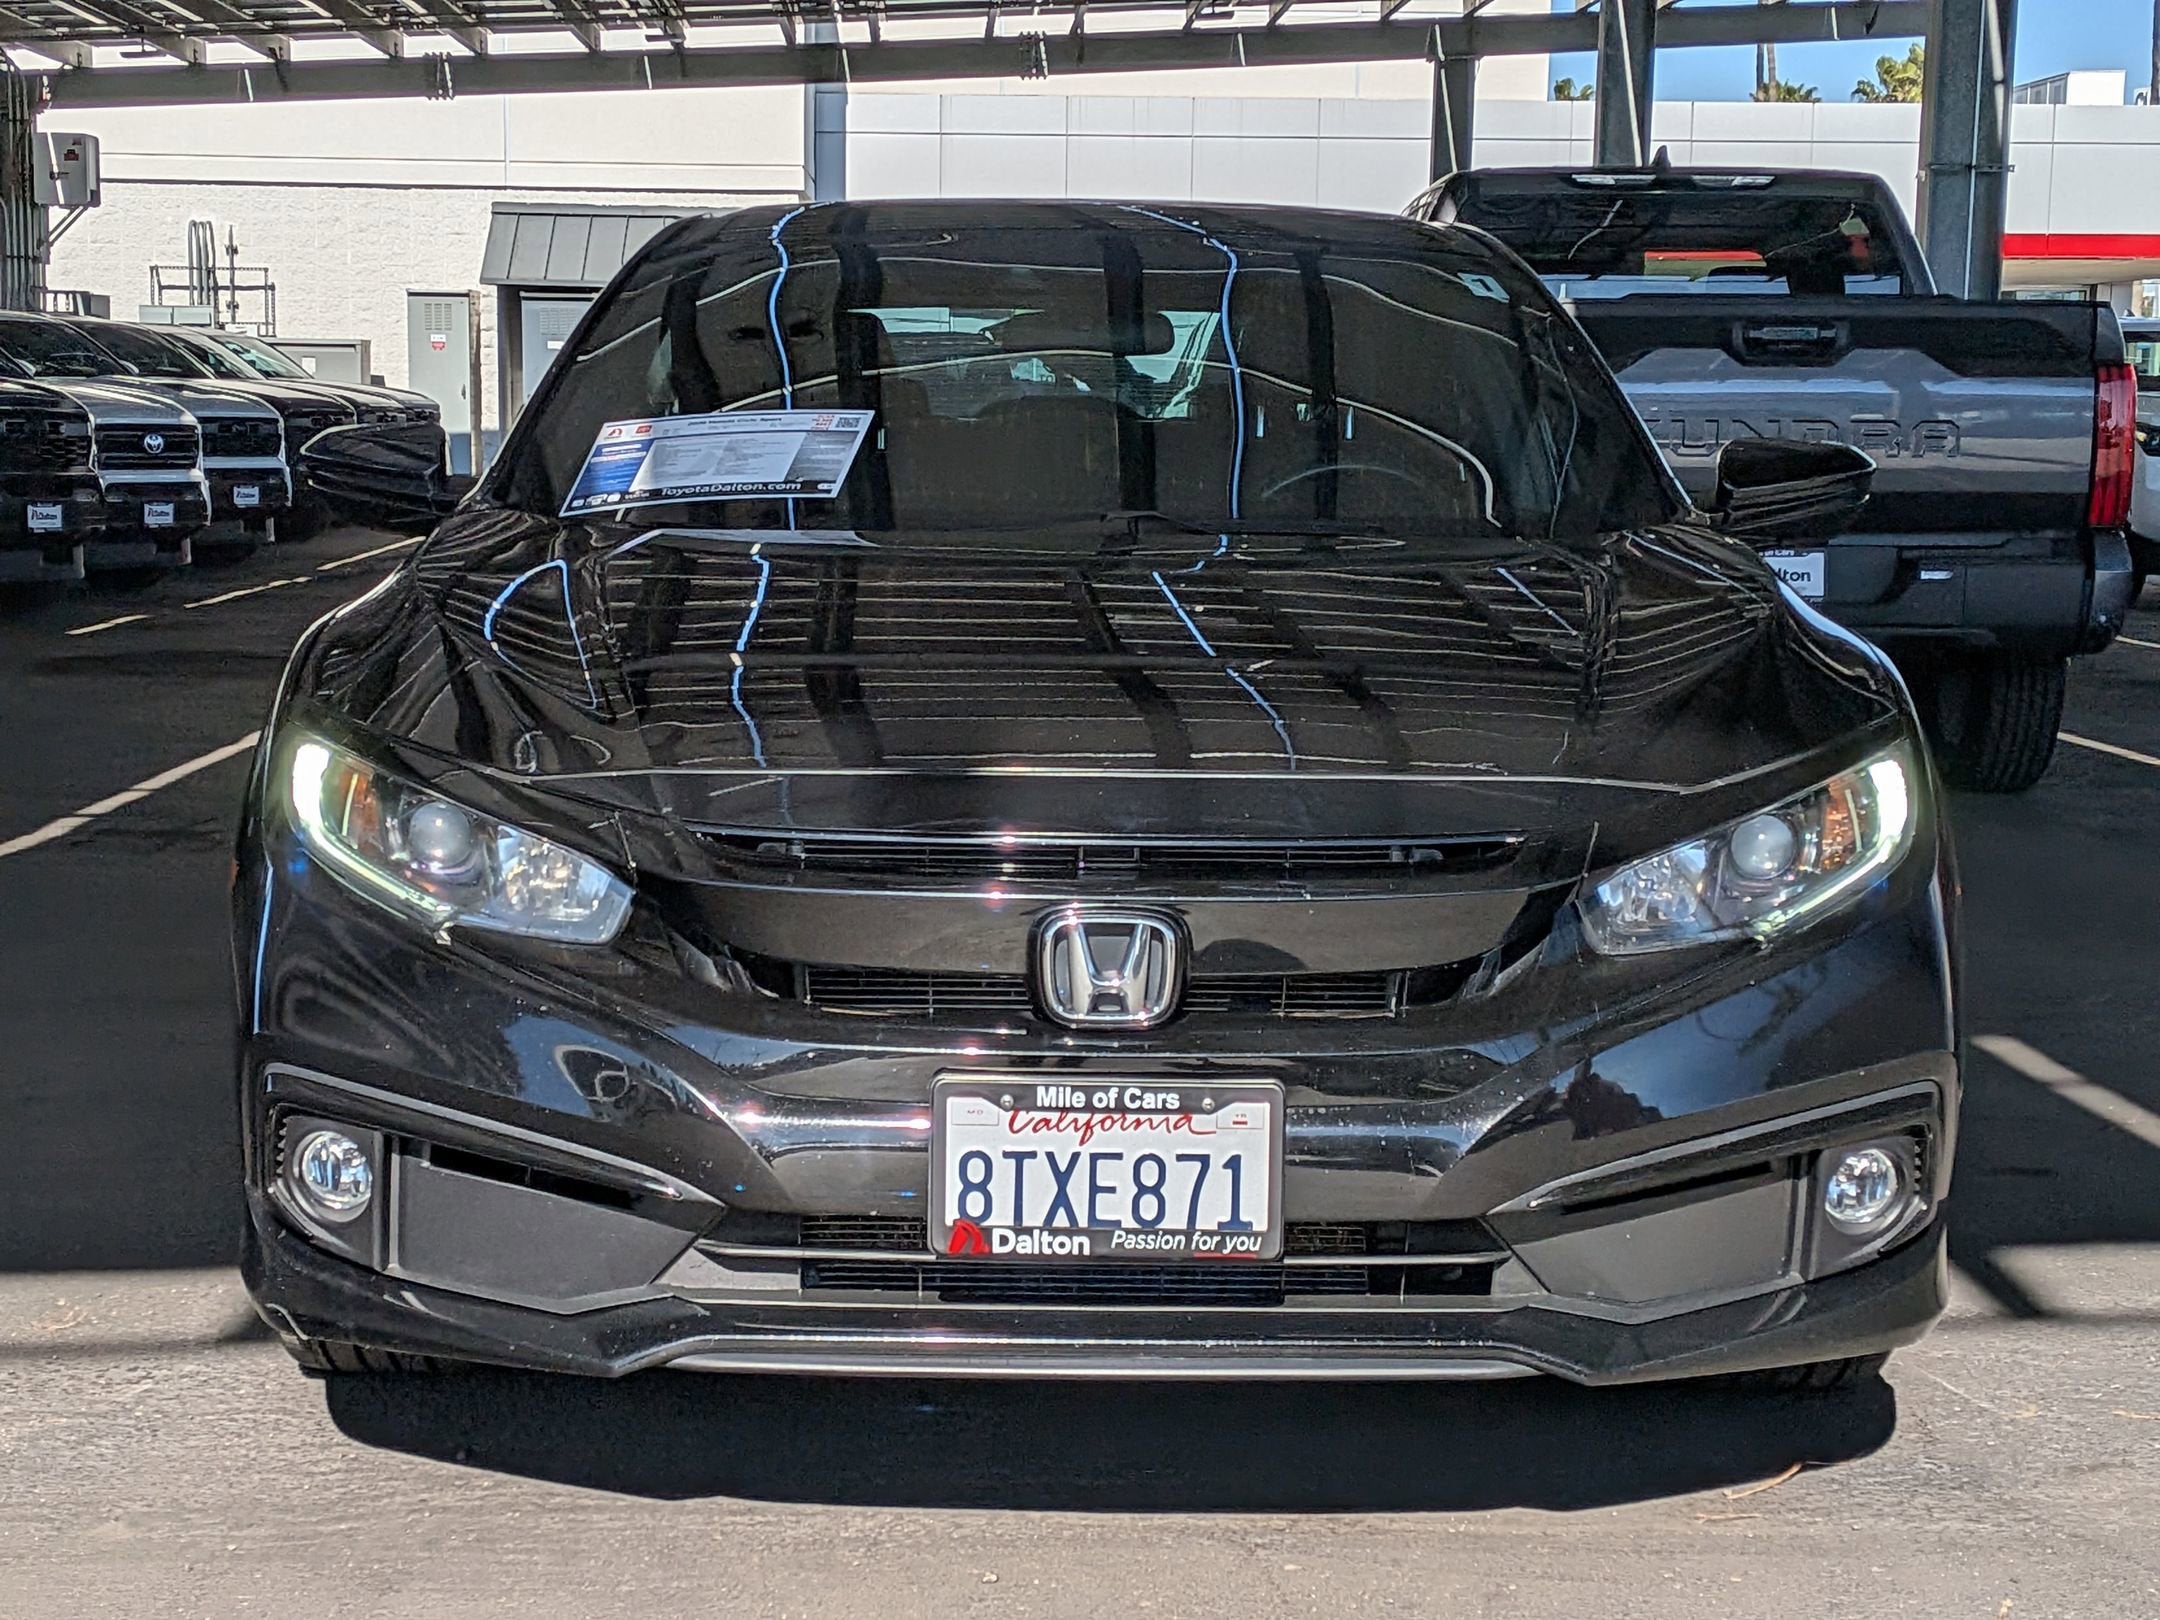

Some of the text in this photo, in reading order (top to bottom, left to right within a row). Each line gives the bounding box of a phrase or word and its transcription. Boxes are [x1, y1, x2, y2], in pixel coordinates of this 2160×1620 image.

[661, 482, 802, 497] ToyotaDalton.com
[1036, 1086, 1181, 1111] Mile of Cars
[1008, 1109, 1217, 1147] California
[957, 1150, 1254, 1232] 8TXE871
[991, 1228, 1091, 1256] Dalton
[1110, 1230, 1262, 1254] Passion for you
